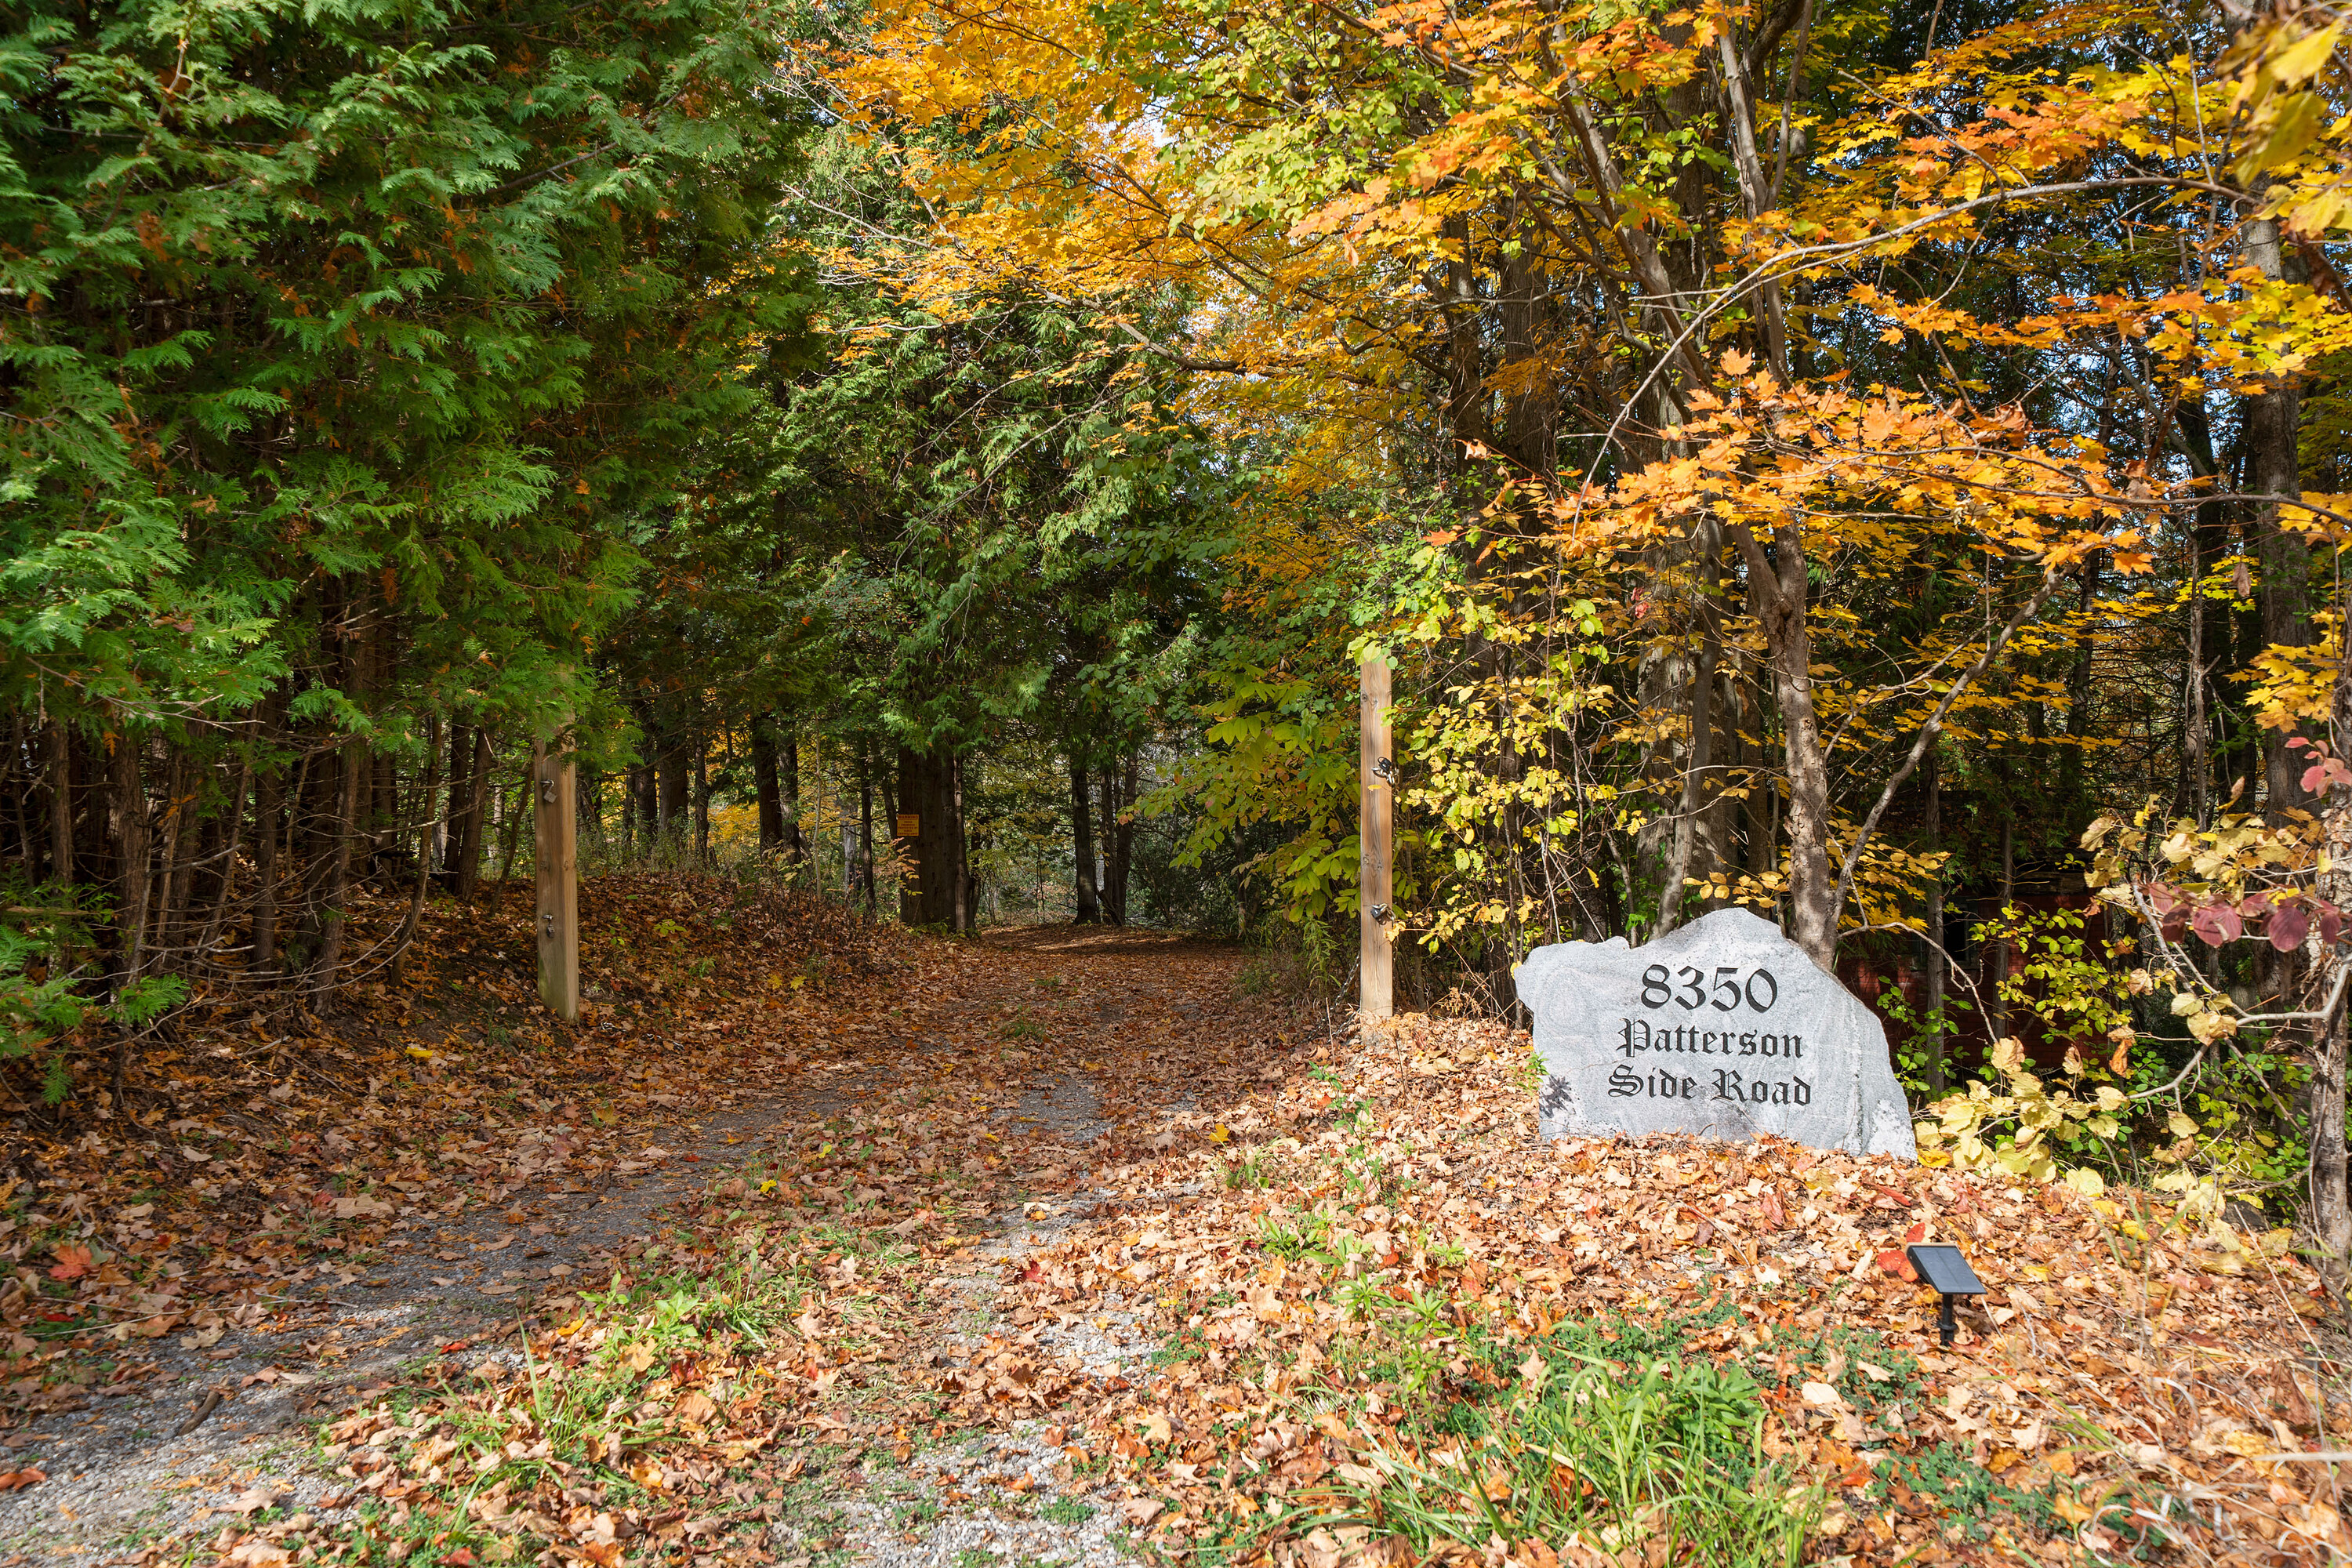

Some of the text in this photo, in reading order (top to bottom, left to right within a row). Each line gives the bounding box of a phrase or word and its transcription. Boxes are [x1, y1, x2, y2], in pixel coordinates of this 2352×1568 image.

[1640, 964, 1778, 1014] 8350
[1615, 1018, 1804, 1058] Patterson
[1607, 1064, 1811, 1106] Side Road
